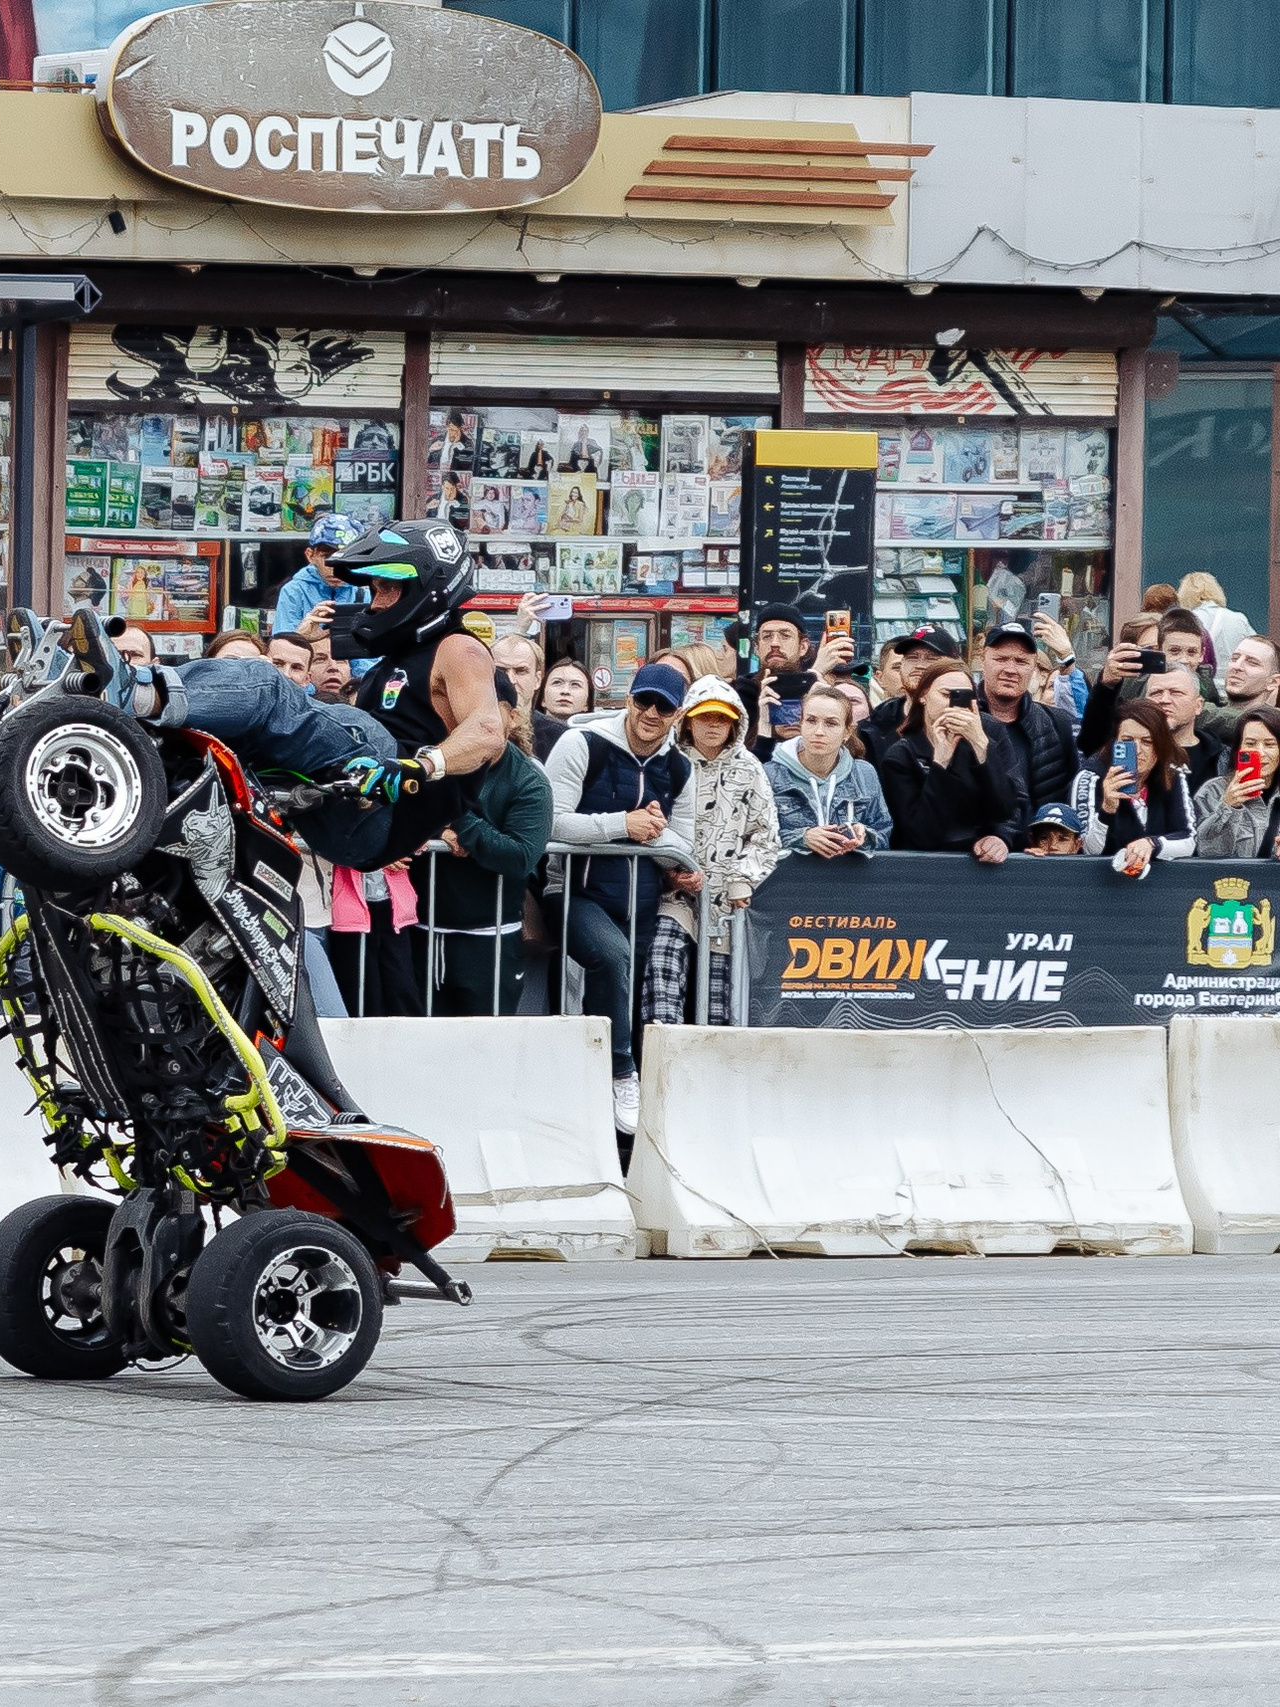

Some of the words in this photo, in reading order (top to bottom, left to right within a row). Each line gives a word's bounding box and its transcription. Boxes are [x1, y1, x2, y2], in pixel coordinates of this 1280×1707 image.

[169, 108, 542, 180] РОСПЕЧАТЬ
[354, 461, 395, 482] РБК
[789, 915, 898, 931] ФЕСТИВАЛЬ
[1006, 933, 1074, 952] УРАЛ
[1134, 993, 1196, 1008] города
